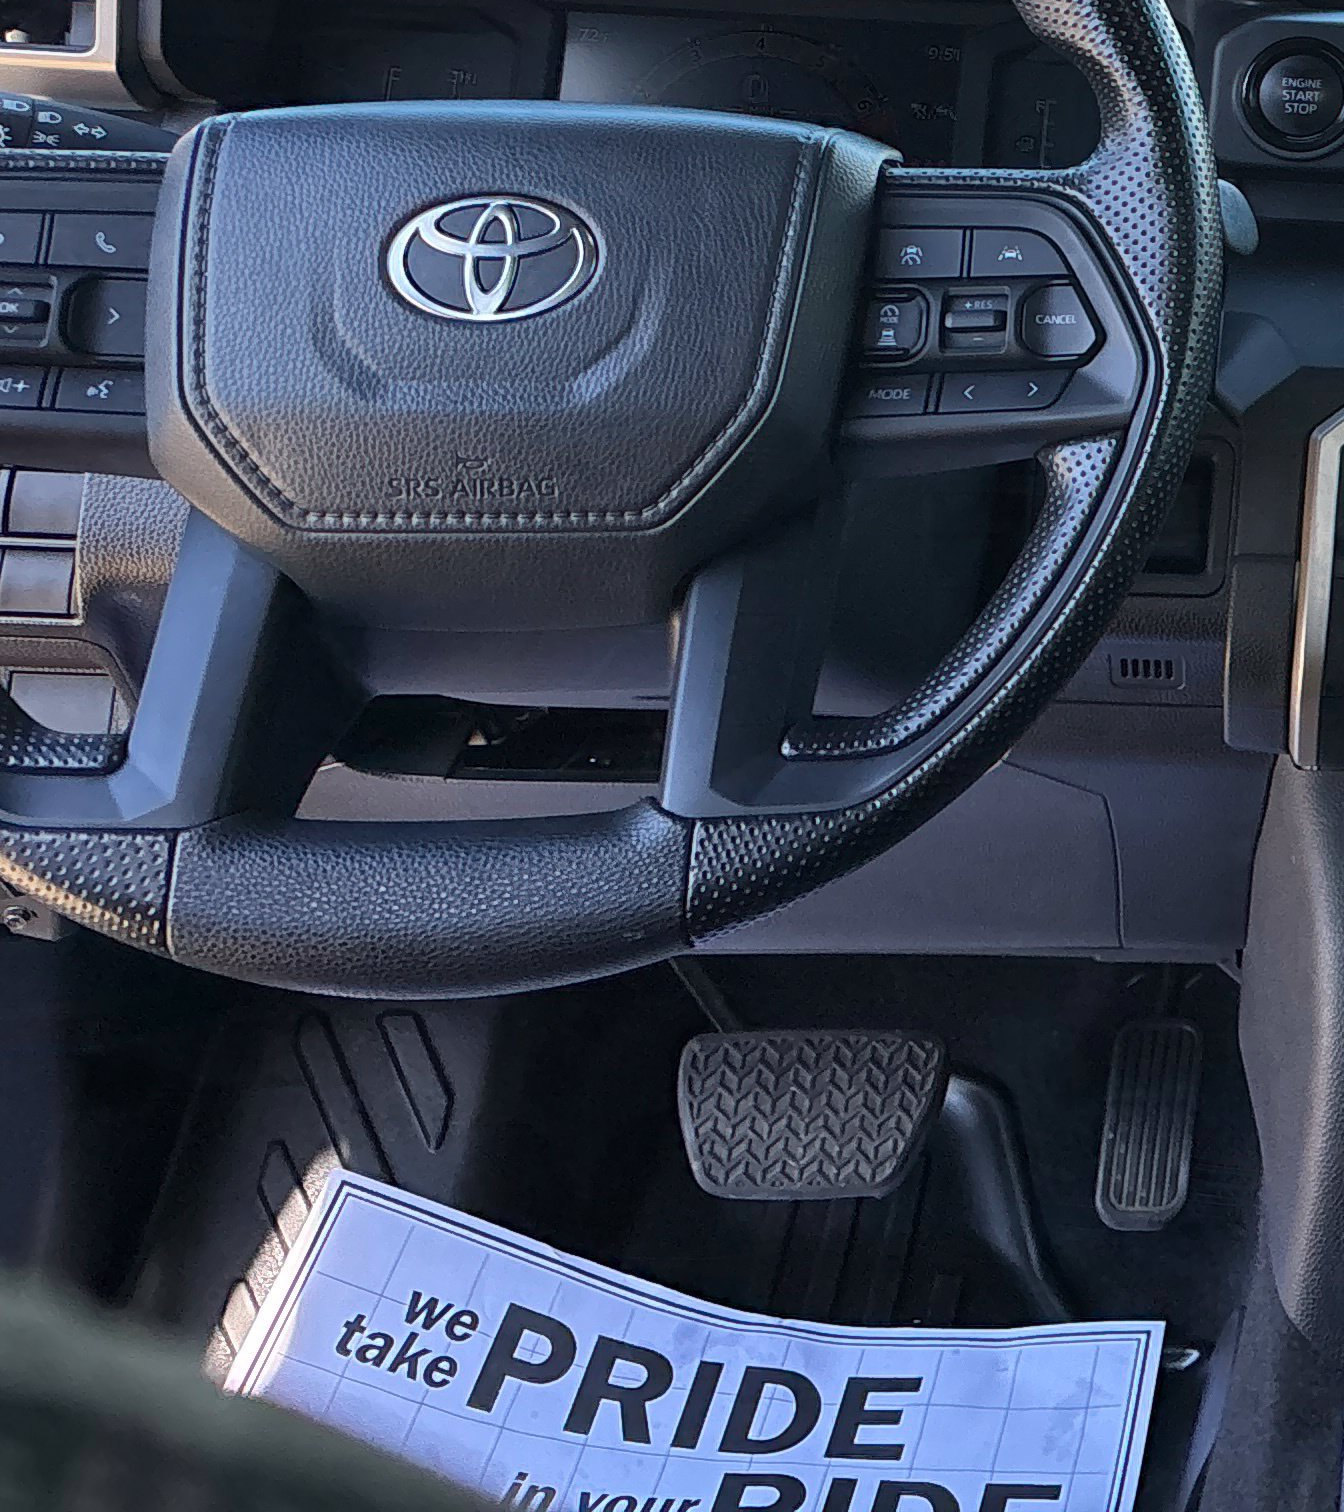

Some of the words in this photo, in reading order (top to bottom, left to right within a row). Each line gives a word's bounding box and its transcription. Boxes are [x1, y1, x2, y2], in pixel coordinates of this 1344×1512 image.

[1281, 77, 1322, 89] ENGINE
[1282, 89, 1321, 102] START
[1284, 102, 1318, 115] STOP
[1035, 314, 1077, 325] CANCEL
[868, 387, 911, 401] MODE
[388, 477, 443, 499] SRS
[452, 477, 559, 500] AIRBAG
[405, 1289, 480, 1342] we
[335, 1313, 458, 1389] take
[466, 1302, 924, 1461] PRIDE
[501, 1471, 557, 1510] in
